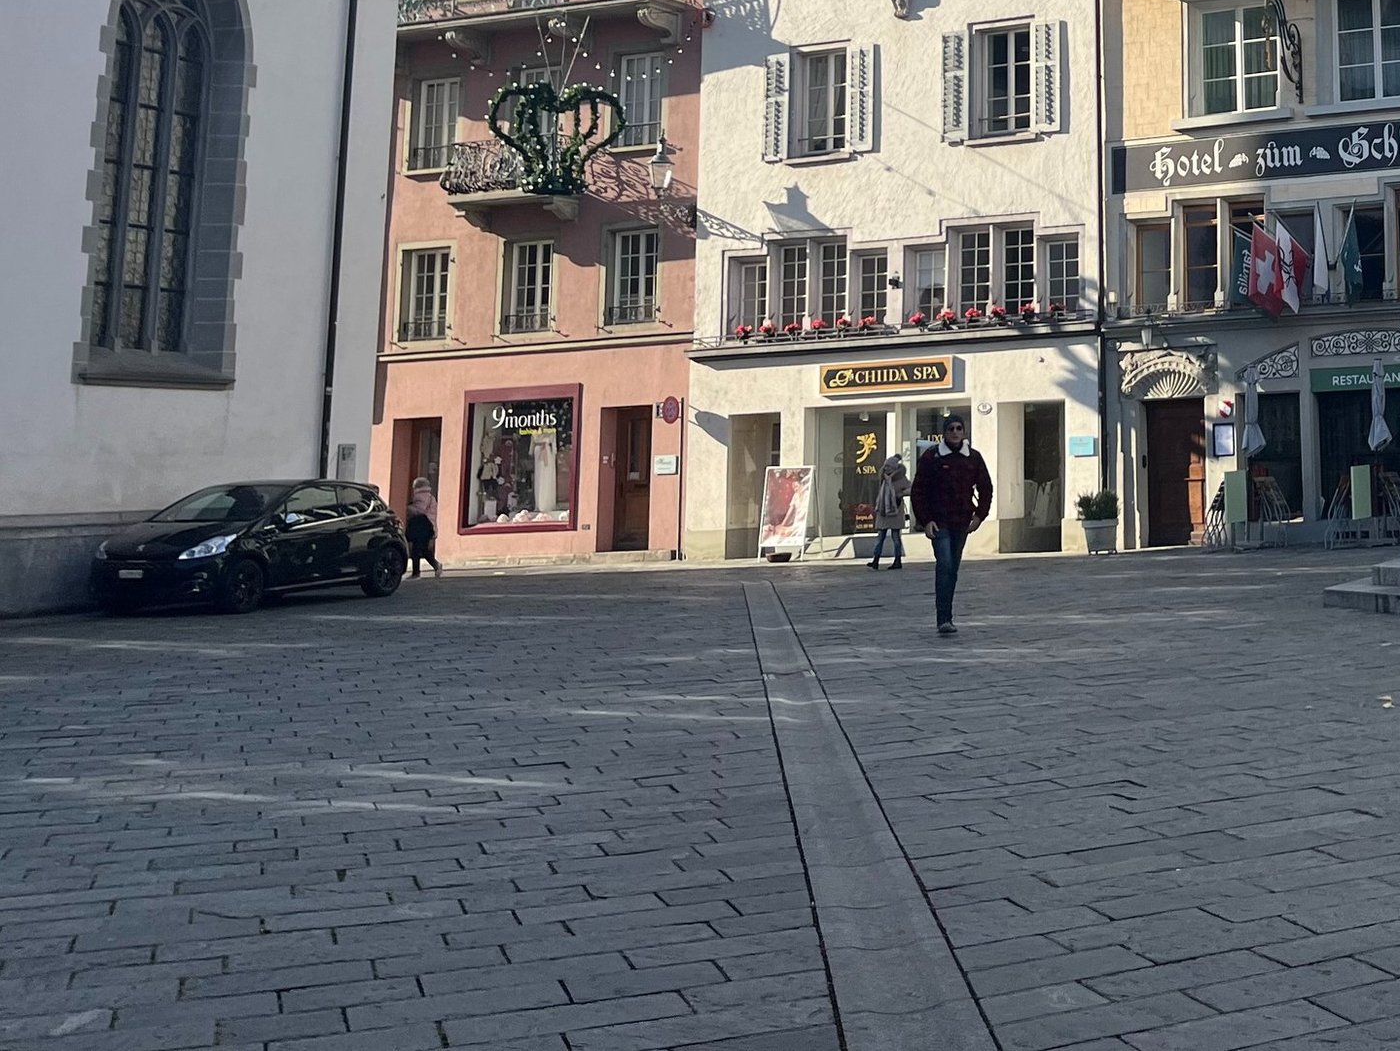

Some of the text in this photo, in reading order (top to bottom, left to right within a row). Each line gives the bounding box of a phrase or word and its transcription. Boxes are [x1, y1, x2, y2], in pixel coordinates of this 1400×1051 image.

[1150, 139, 1225, 186] Hotel
[854, 366, 940, 384] CHIIDA SPA
